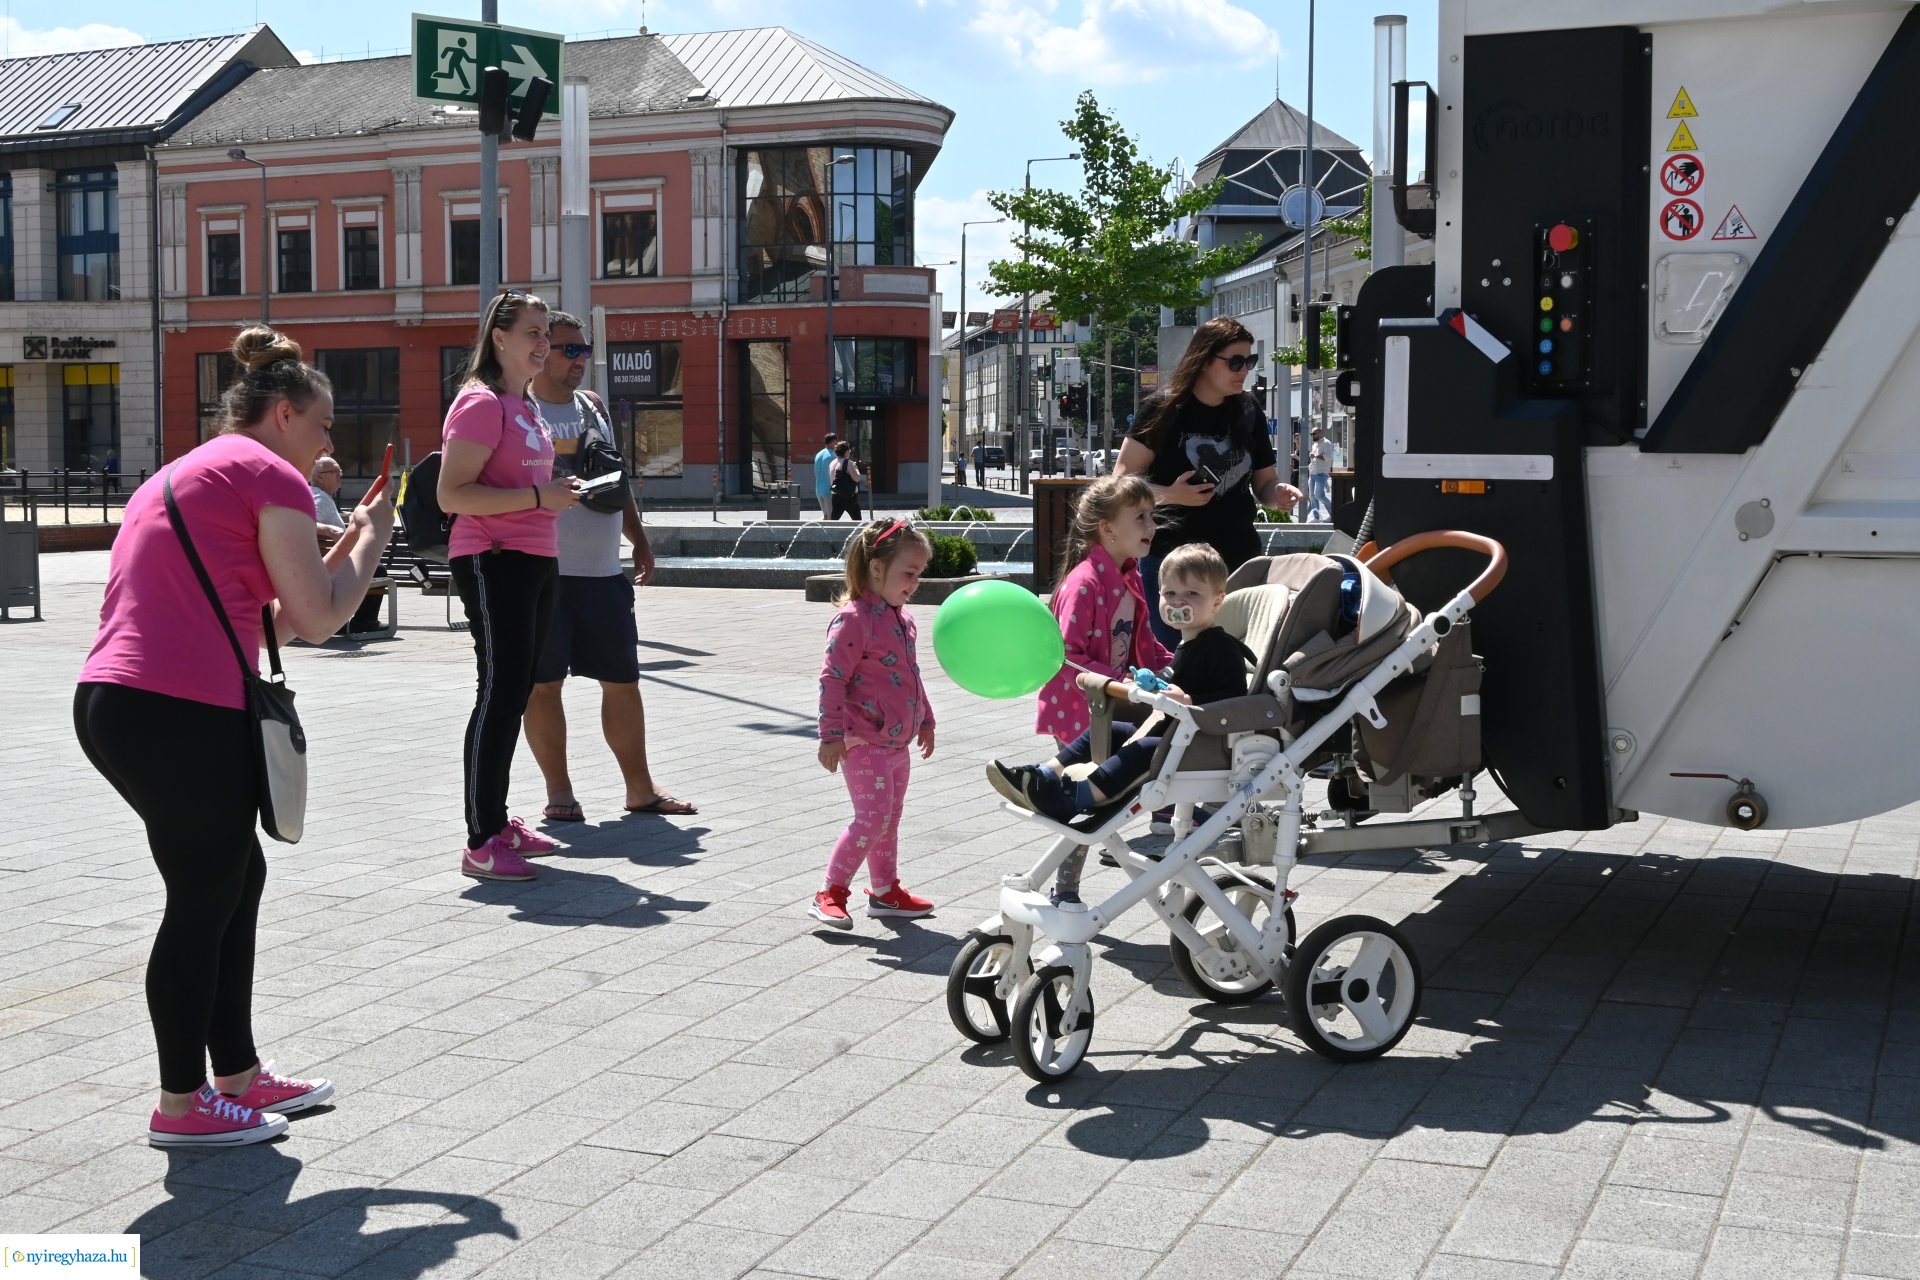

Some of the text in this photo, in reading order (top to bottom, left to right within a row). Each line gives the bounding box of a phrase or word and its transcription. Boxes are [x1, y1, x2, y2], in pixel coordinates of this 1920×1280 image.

[644, 316, 777, 338] FASHION
[51, 336, 116, 348] Raiffeisen
[52, 349, 92, 359] BANK
[613, 349, 652, 370] KIADÓ
